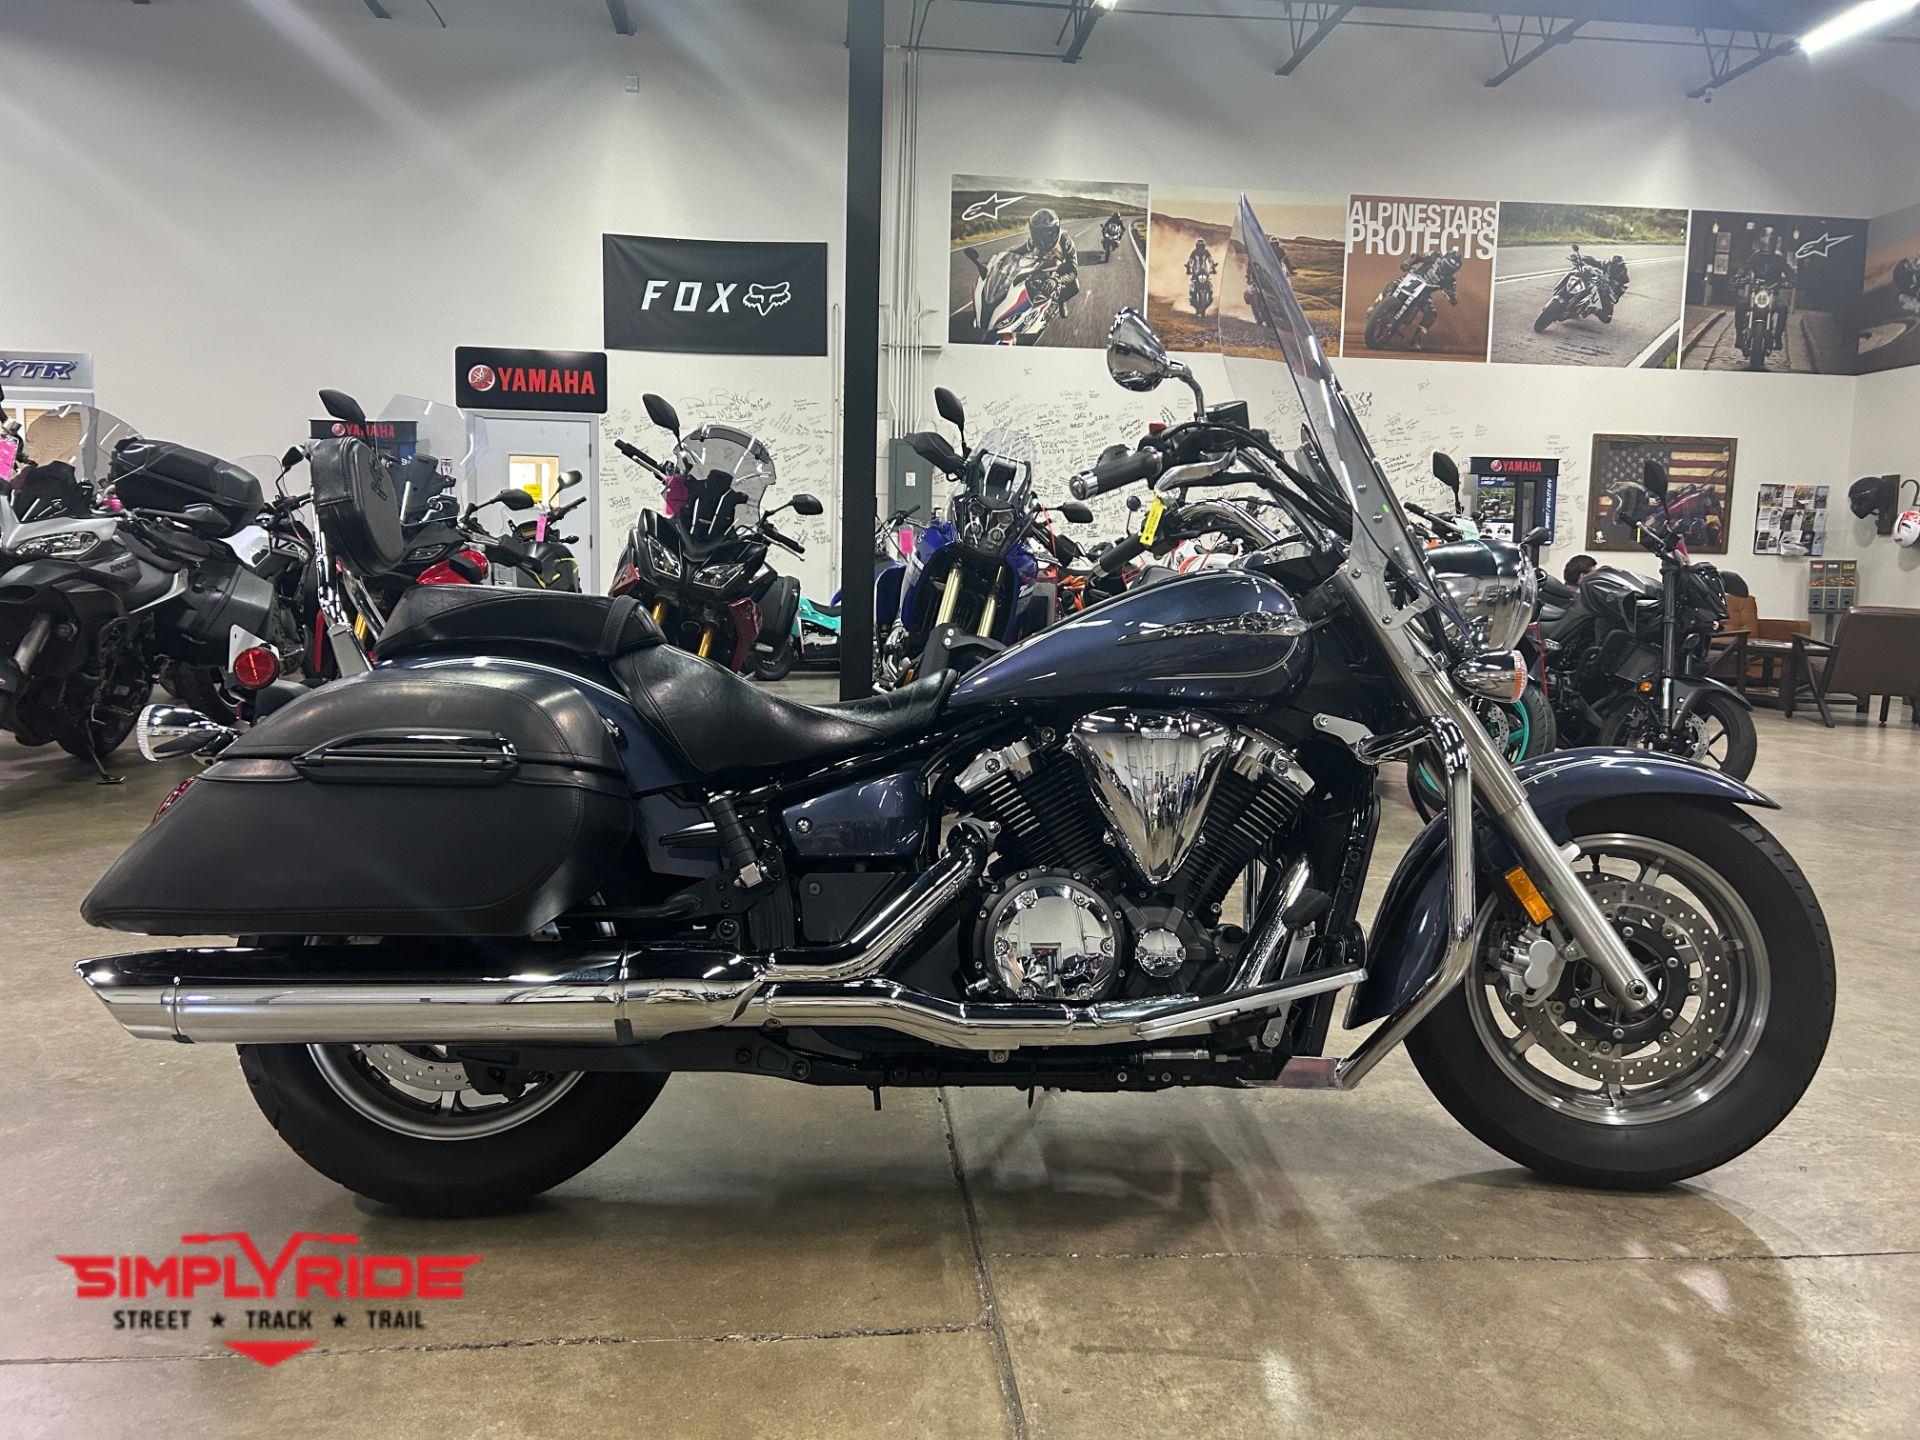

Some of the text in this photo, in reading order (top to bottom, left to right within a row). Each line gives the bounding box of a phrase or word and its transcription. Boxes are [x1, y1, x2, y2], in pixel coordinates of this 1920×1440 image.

[1350, 201, 1496, 232] ALPINESTARS
[1347, 223, 1495, 260] PROTECTS
[641, 280, 737, 313] FOX
[498, 367, 595, 395] YAMAHA
[1502, 461, 1542, 472] YAMAHA
